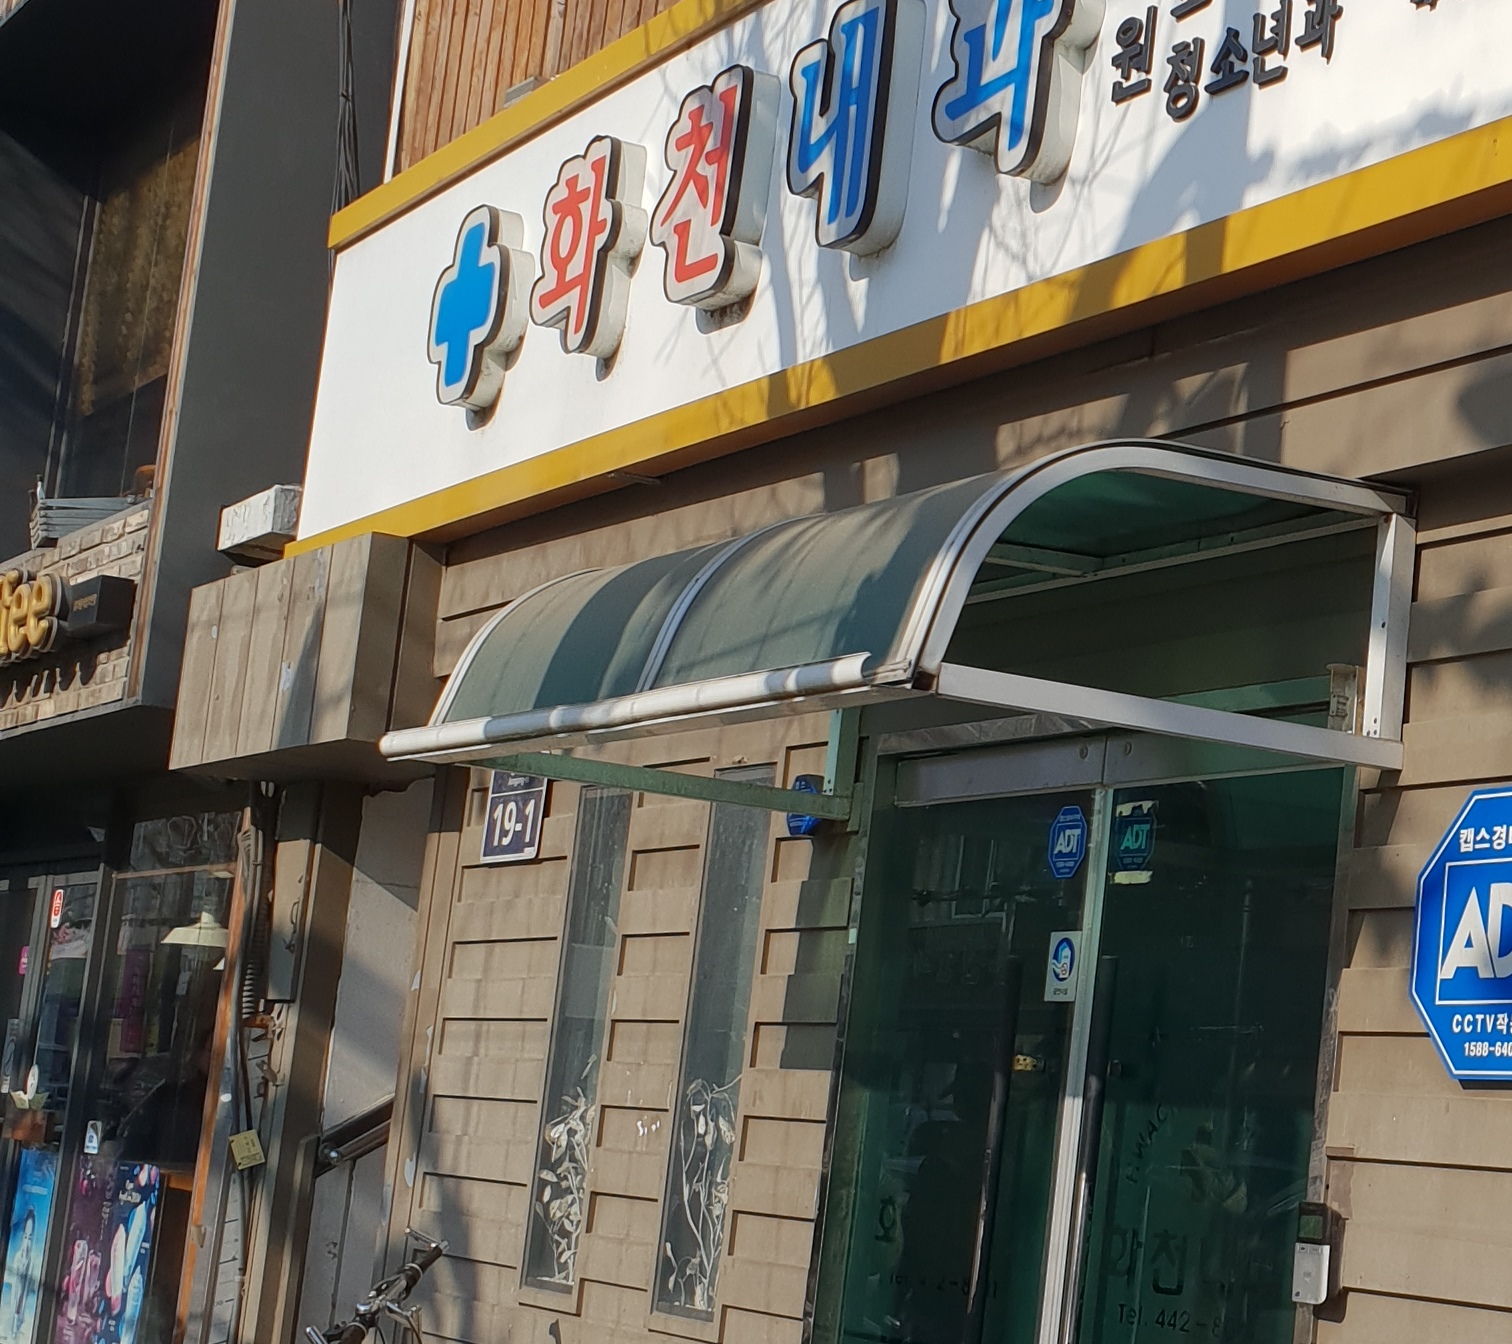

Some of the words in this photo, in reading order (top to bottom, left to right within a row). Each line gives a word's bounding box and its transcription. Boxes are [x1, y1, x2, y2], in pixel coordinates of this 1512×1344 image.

[492, 798, 536, 848] 19-1
[1120, 823, 1151, 850] ADT
[1053, 828, 1082, 855] ADT
